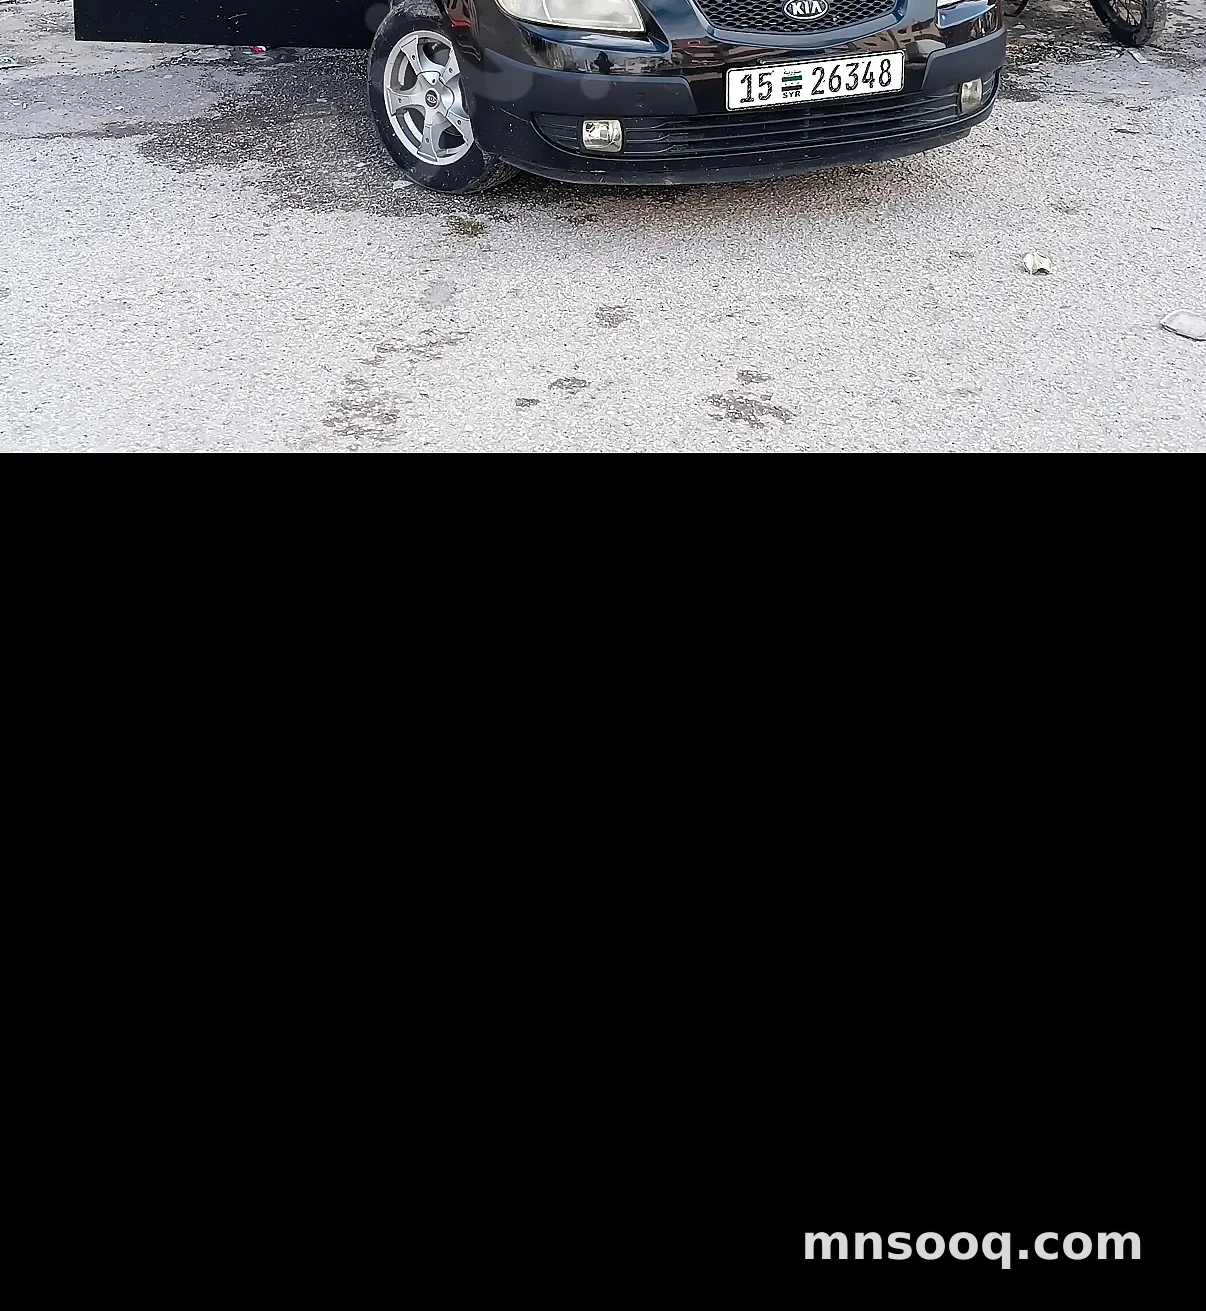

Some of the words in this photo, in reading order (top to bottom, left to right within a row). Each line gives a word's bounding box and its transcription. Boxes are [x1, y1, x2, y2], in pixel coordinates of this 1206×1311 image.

[740, 69, 774, 104] 15
[811, 58, 892, 97] 26348
[783, 90, 801, 99] SYR
